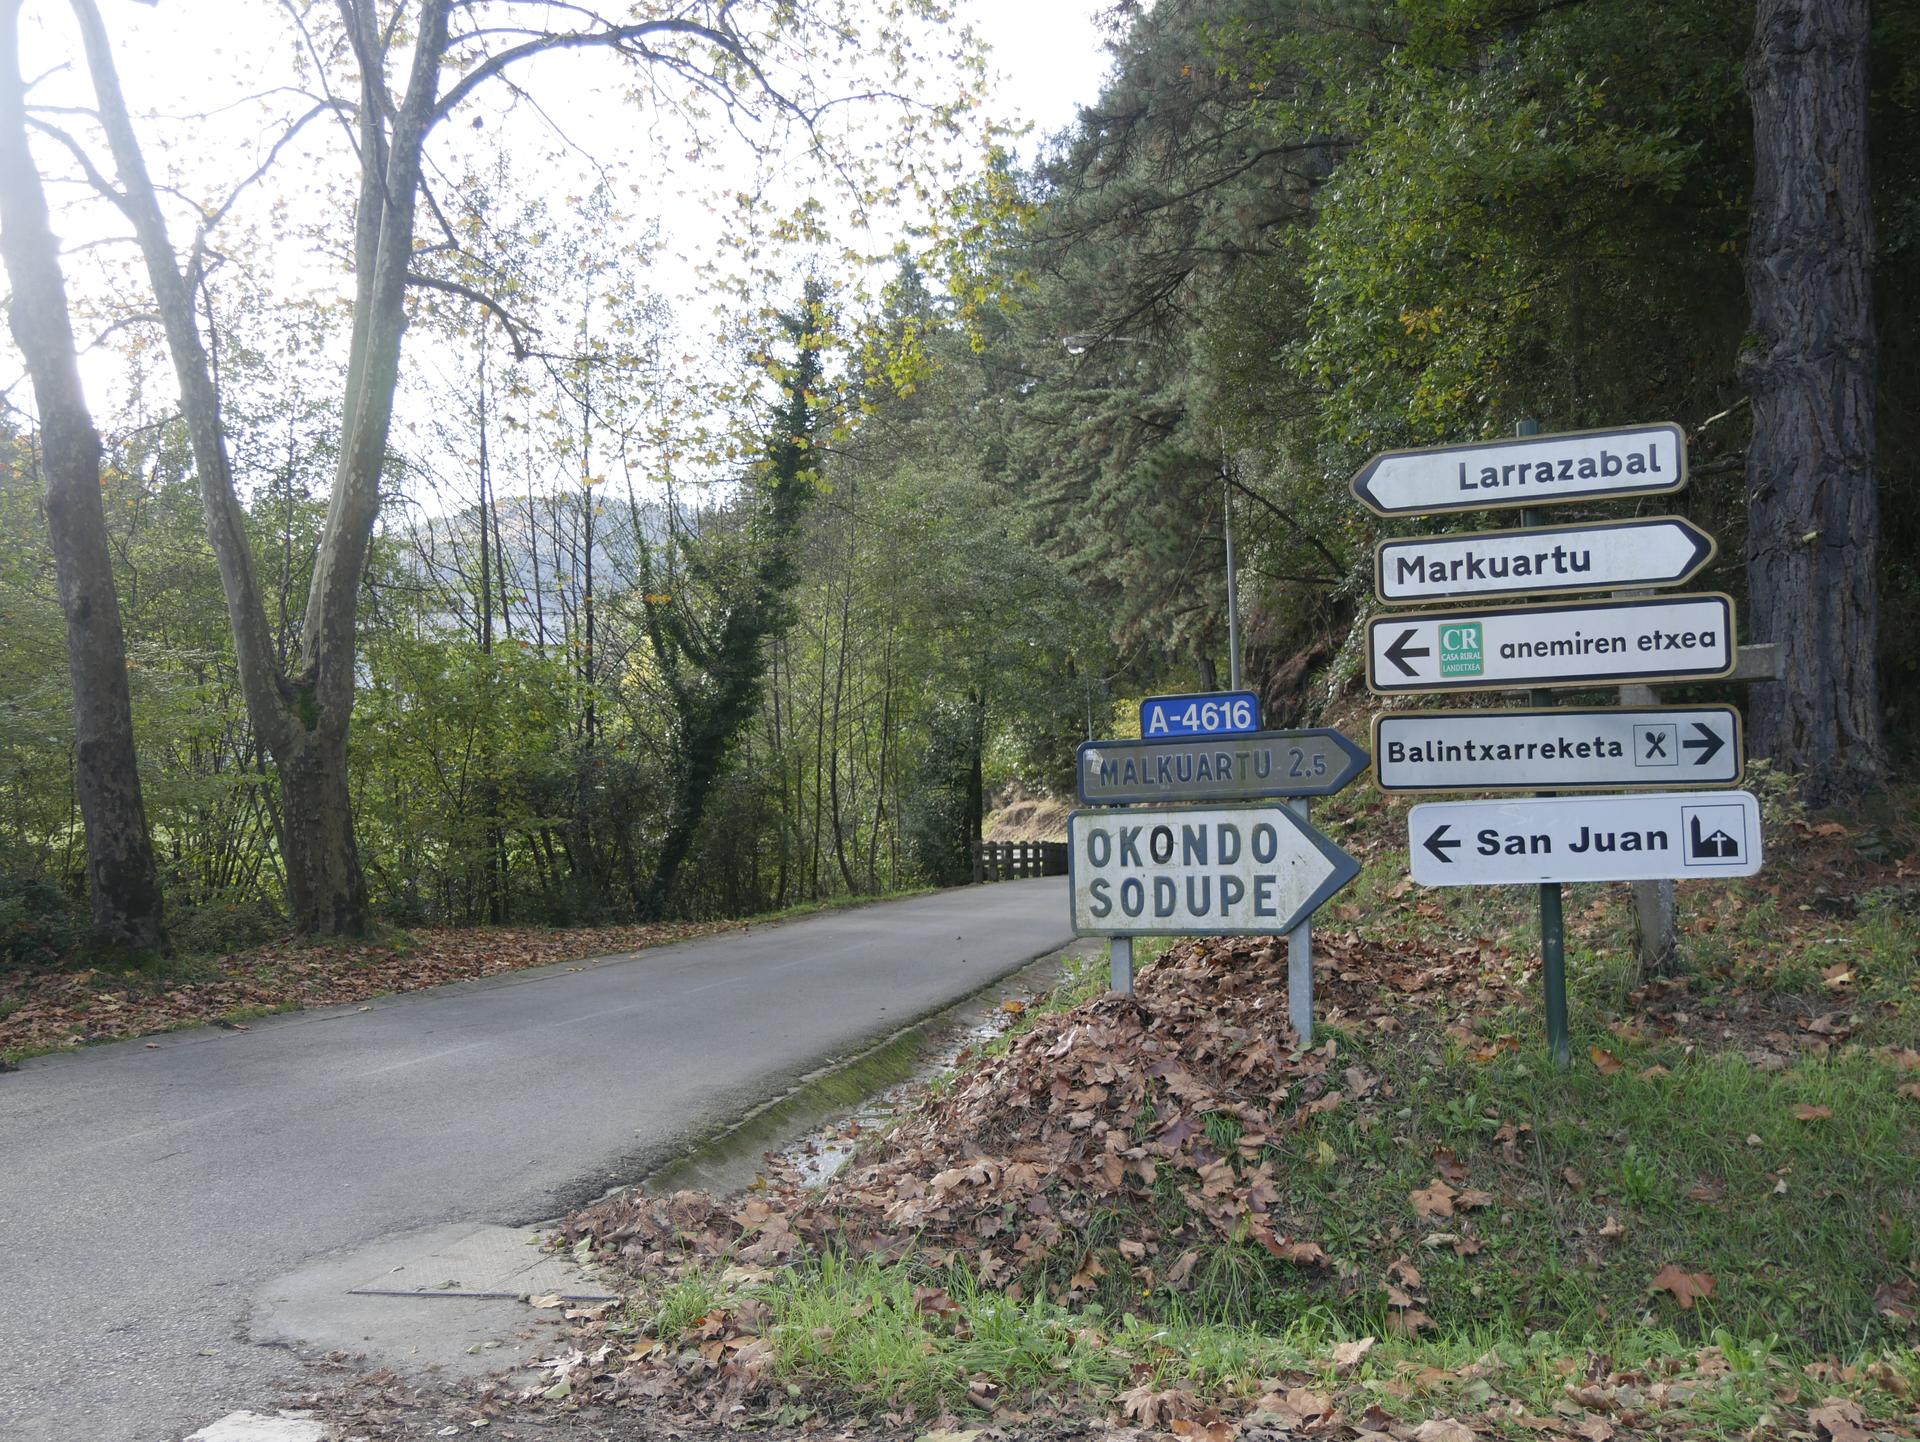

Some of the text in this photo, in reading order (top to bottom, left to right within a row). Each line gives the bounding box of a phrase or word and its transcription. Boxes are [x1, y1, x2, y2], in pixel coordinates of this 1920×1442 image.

[1458, 443, 1661, 490] Larrazabal
[1396, 545, 1591, 585] Markuartu
[1443, 628, 1478, 650] CR
[1499, 630, 1716, 659] anemiren etxea
[1441, 653, 1459, 661] CASA
[1149, 700, 1251, 734] A-4616
[1387, 736, 1624, 763] Balintxarreketa
[1100, 750, 1271, 786] MALKUARTU
[1087, 822, 1278, 868] OKONDO
[1477, 826, 1668, 856] San Juan
[1089, 875, 1277, 918] SODUPE
